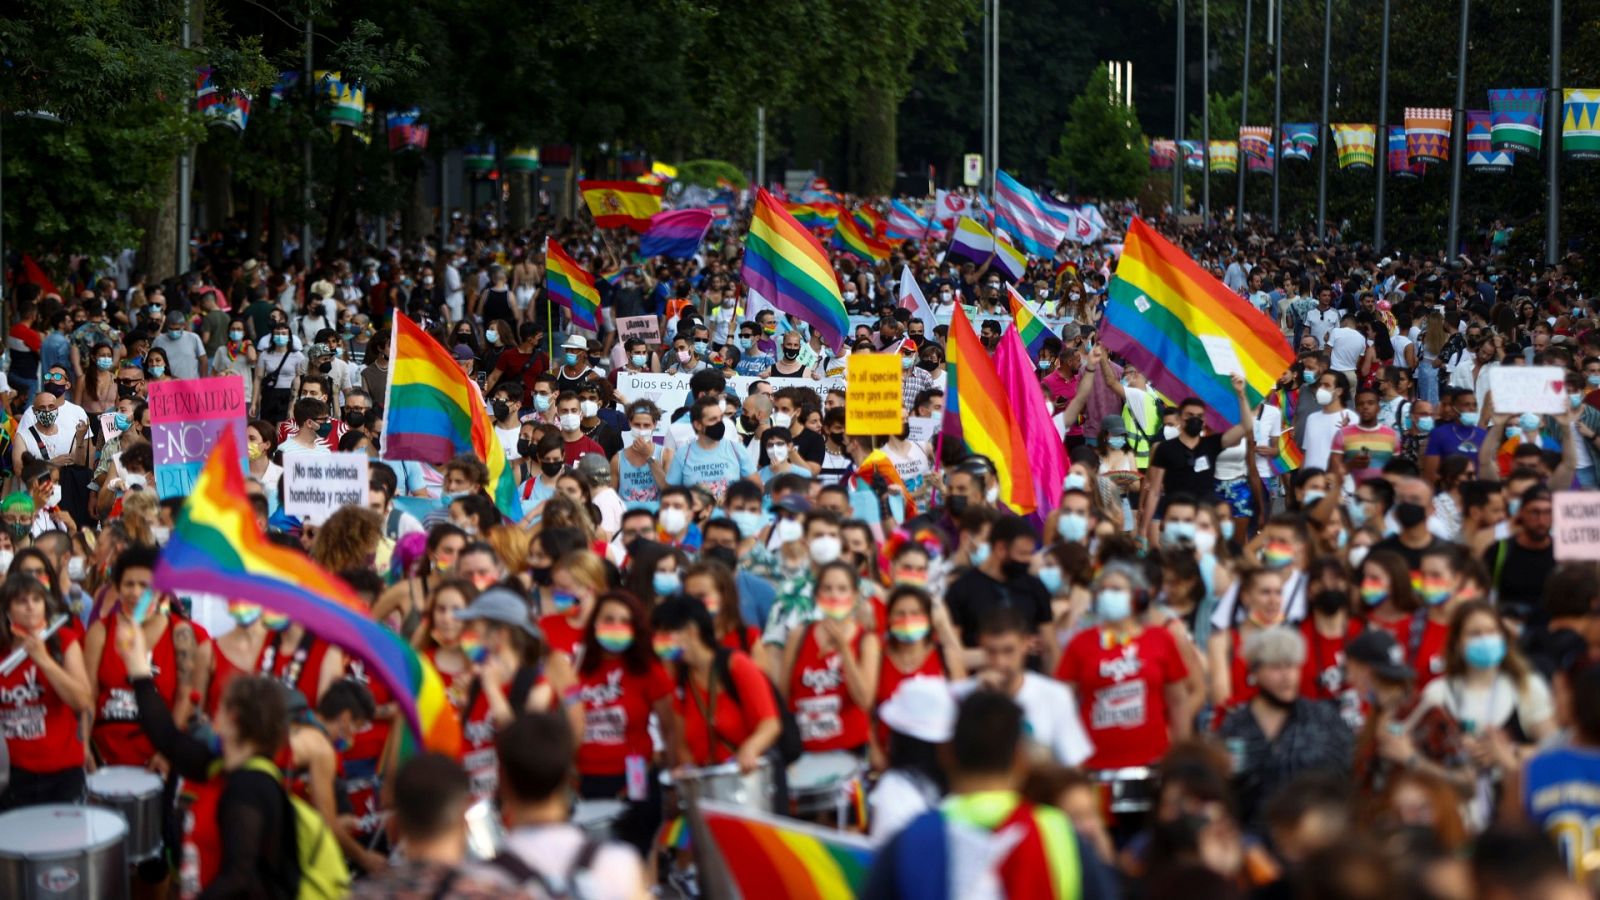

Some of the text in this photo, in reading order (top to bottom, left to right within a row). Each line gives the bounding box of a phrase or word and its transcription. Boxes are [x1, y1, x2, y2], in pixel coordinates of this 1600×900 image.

[631, 378, 657, 389] Dios
[660, 380, 673, 390] es
[869, 370, 899, 385] species
[152, 388, 240, 417] BISEXUALIDAD
[168, 424, 205, 458] NO
[307, 462, 323, 479] más
[325, 463, 358, 480] violencia
[693, 462, 729, 472] DERECHOS
[701, 469, 725, 477] TRANS
[624, 471, 653, 479] DERECH
[289, 486, 362, 509] homófoba y racista!
